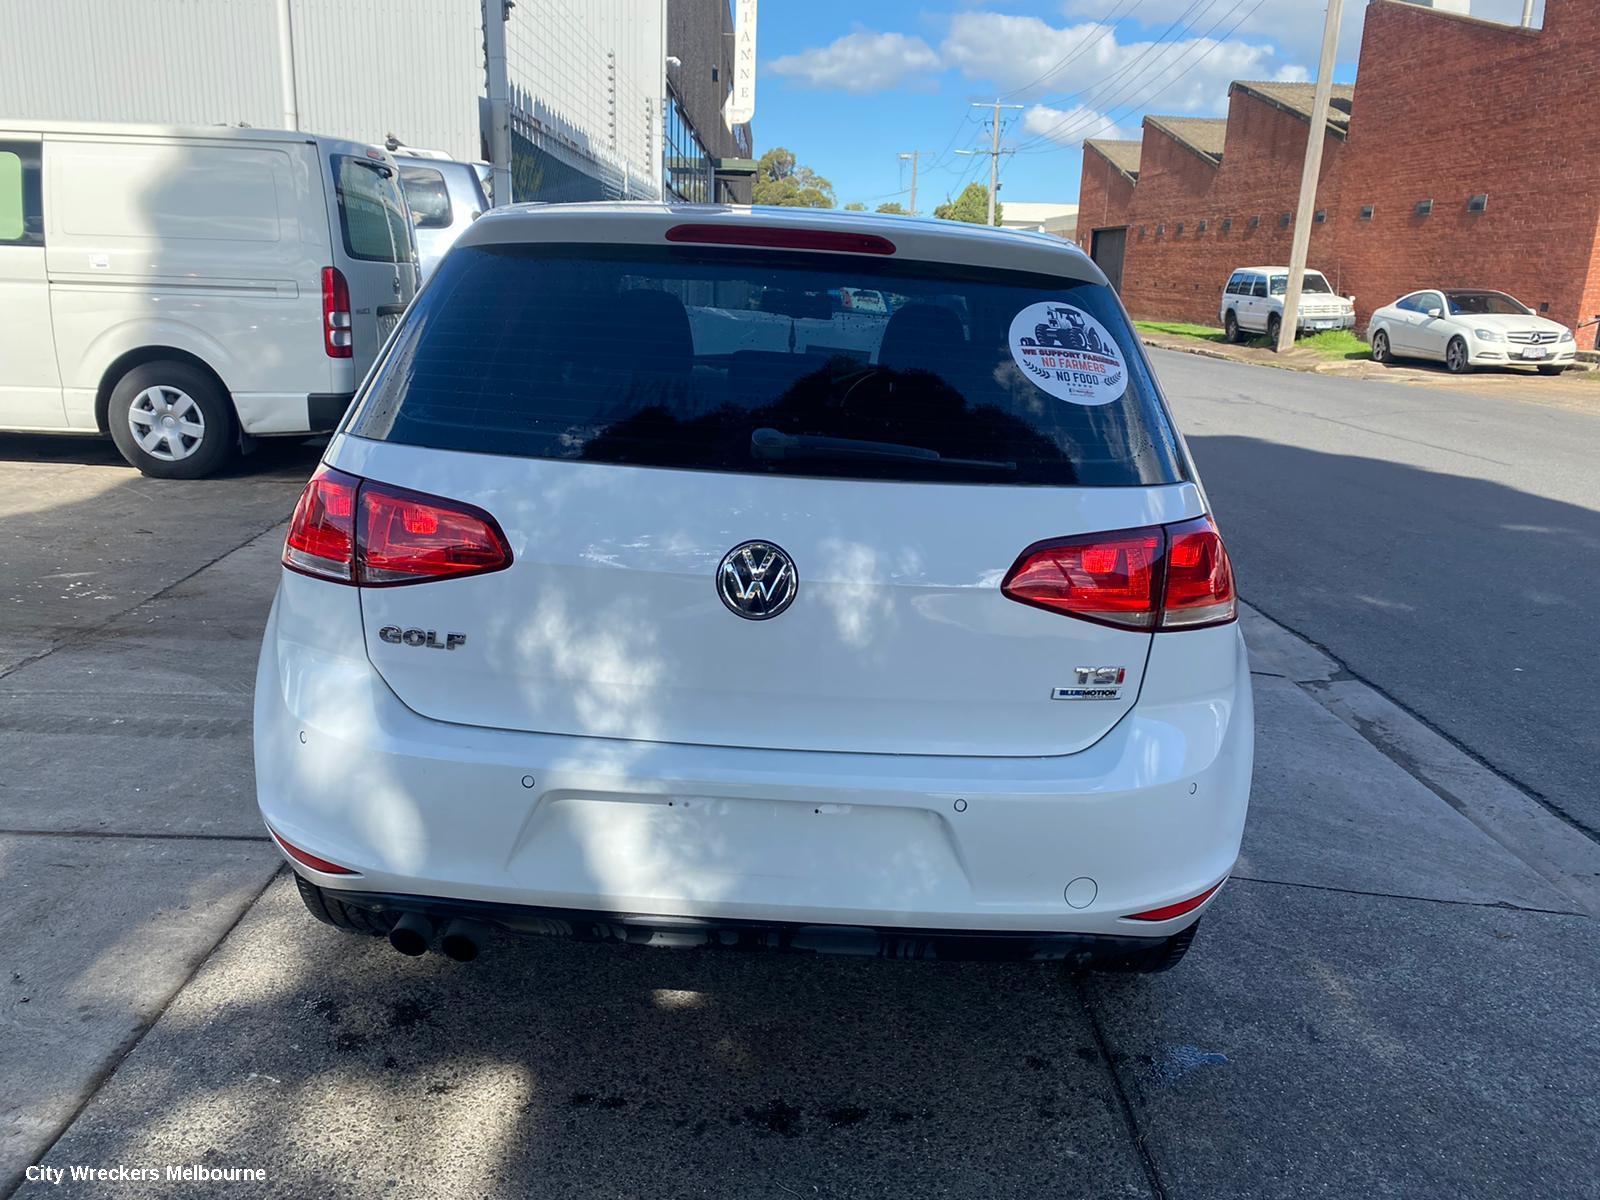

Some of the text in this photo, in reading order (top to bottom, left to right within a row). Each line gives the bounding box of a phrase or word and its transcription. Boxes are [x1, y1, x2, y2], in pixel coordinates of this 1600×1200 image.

[1022, 348, 1037, 356] WE
[1039, 348, 1080, 359] SUPPORT
[1042, 357, 1106, 373] NO FARMERS
[1056, 371, 1099, 385] NO FOOD
[379, 624, 466, 651] GOLF
